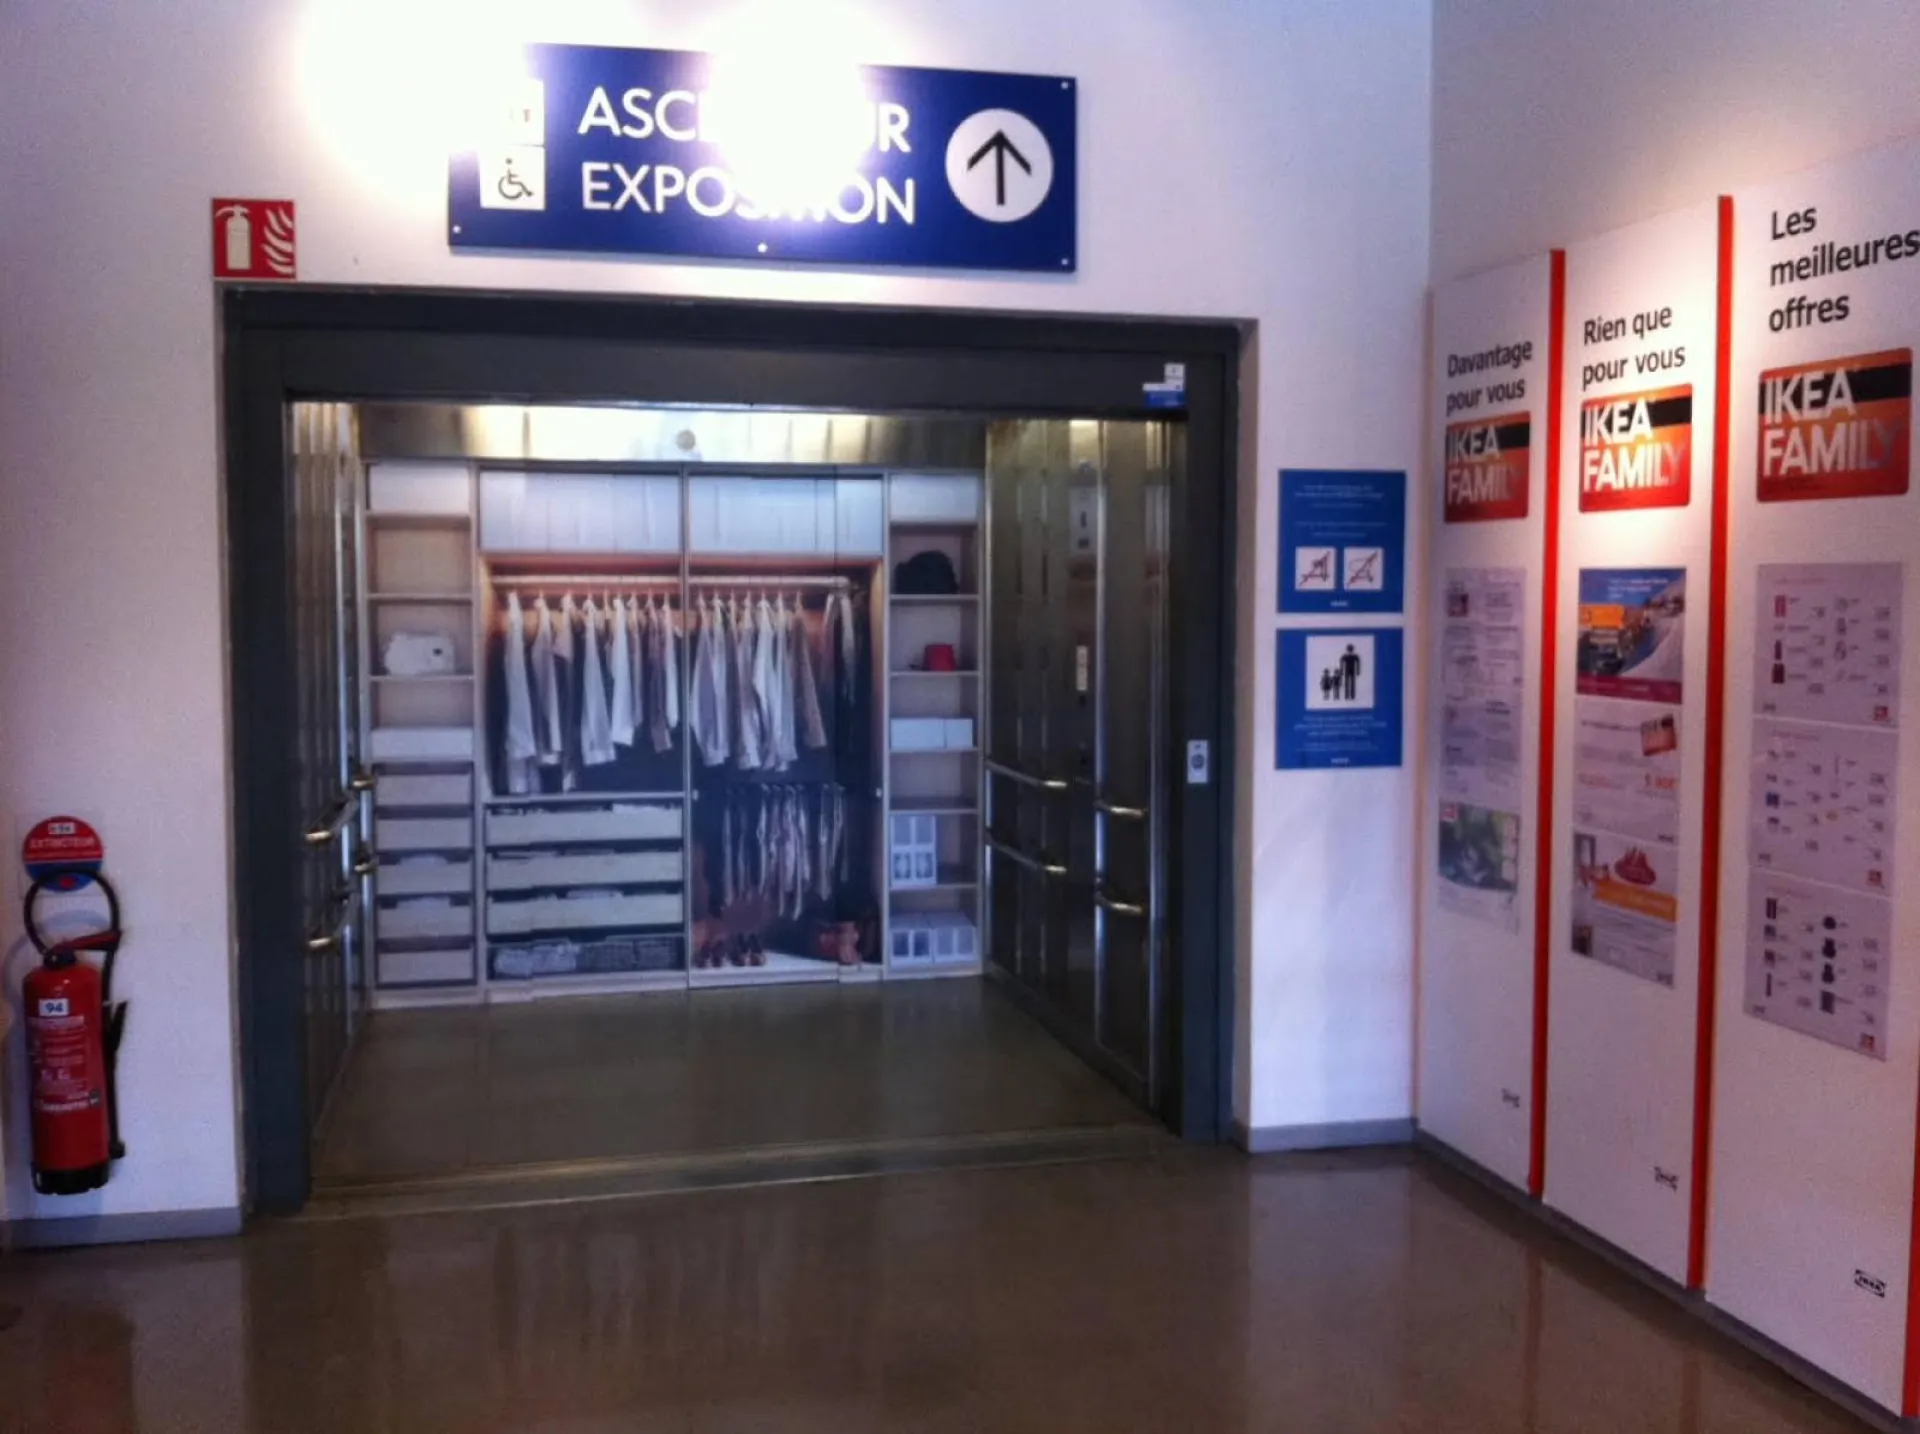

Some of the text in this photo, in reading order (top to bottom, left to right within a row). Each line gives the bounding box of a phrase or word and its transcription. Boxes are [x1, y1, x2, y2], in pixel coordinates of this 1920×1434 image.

[1771, 207, 1817, 241] Les
[1770, 229, 1920, 287] meilleures
[1584, 306, 1672, 346] Rien que
[1769, 295, 1850, 333] offres
[1447, 340, 1533, 378] Davantage
[1582, 346, 1686, 392] pour vous
[1446, 379, 1525, 418] pour vous
[1763, 367, 1857, 425] IKEA
[1584, 397, 1654, 447] IKEA
[1447, 424, 1501, 463] IKEA
[1763, 419, 1898, 478] FAMILY
[1583, 441, 1685, 492] FAMILY
[45, 1002, 64, 1014] 94
